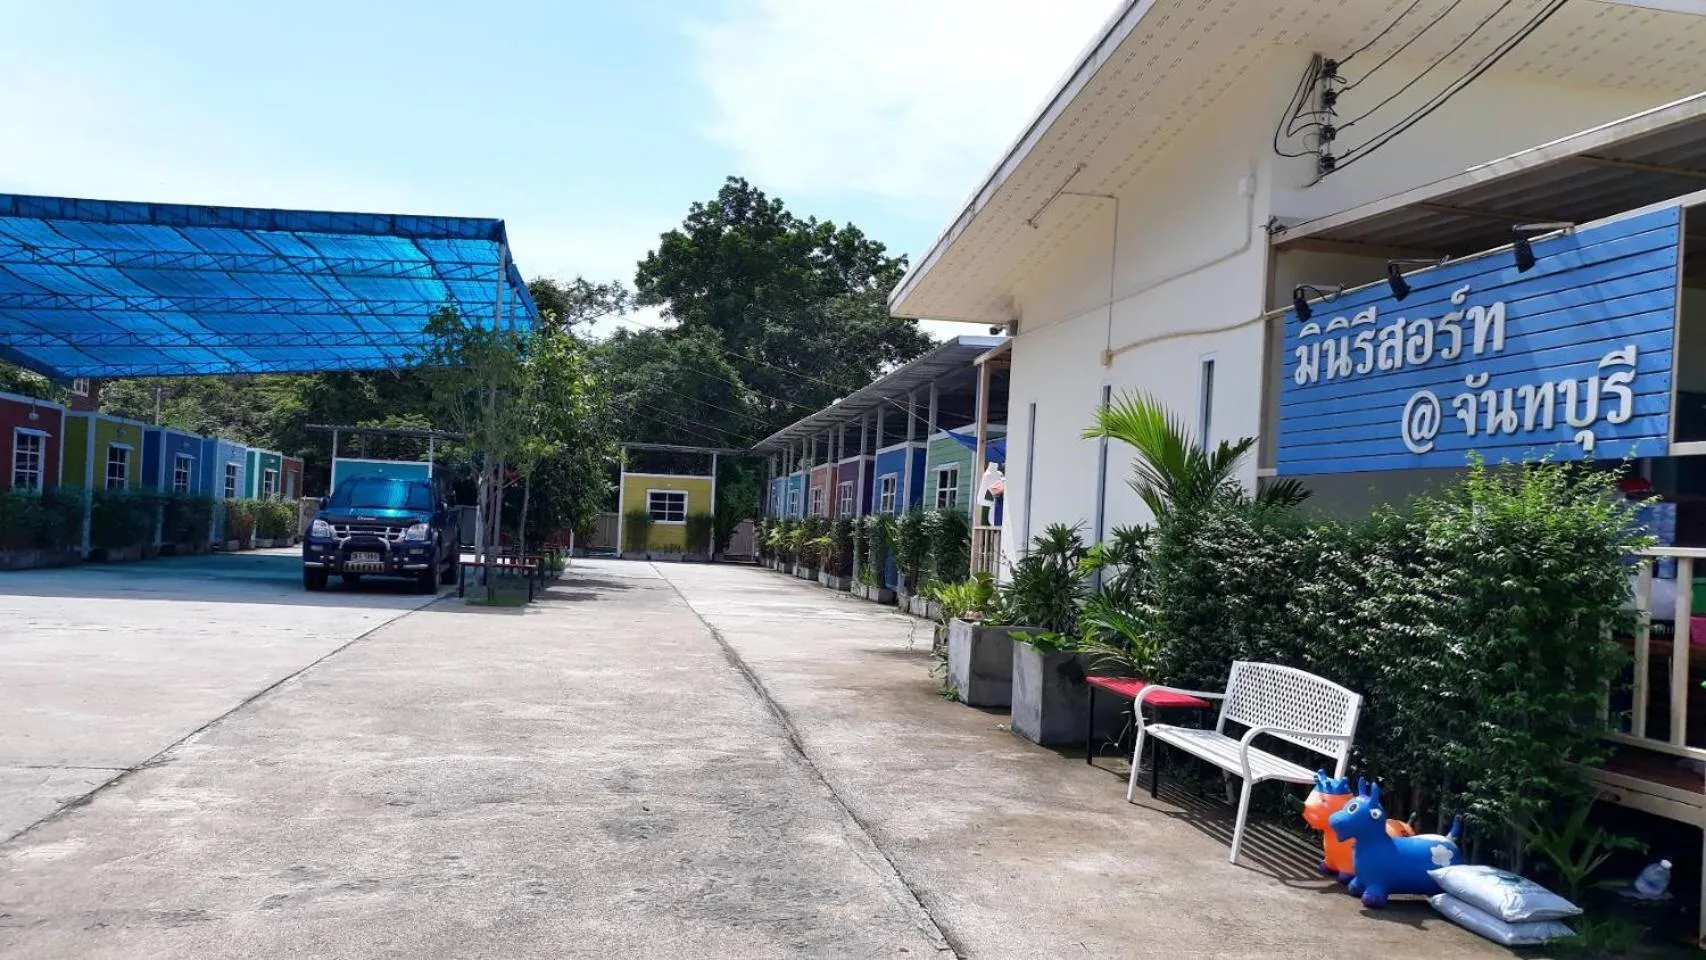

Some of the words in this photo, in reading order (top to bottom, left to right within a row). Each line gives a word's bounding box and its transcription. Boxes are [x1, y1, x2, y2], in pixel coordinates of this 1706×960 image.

[1295, 284, 1506, 385] มินิรีสอร์ท
[1452, 345, 1637, 452] จันทบุรี
